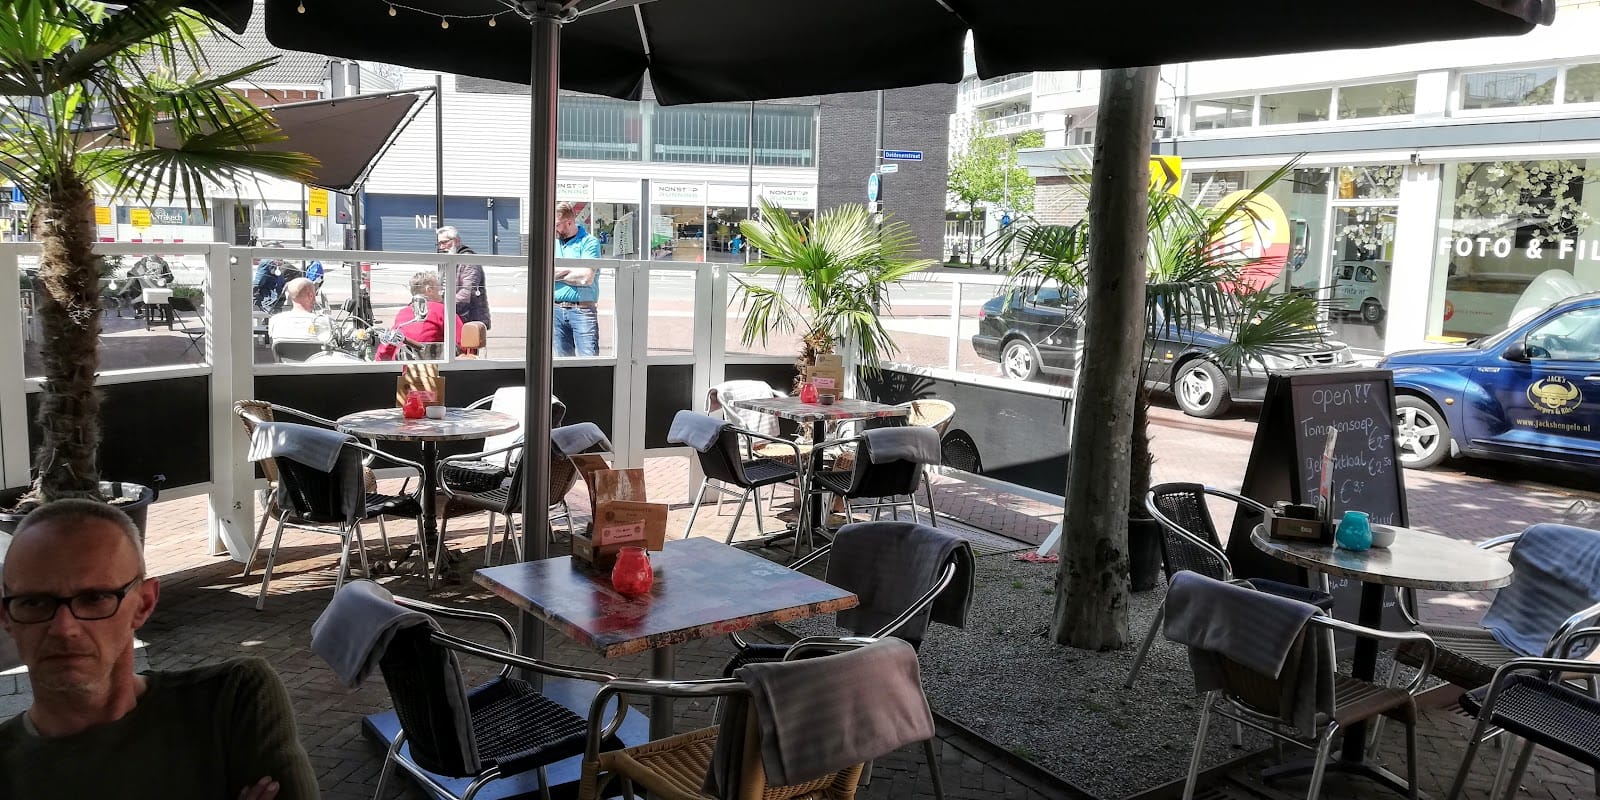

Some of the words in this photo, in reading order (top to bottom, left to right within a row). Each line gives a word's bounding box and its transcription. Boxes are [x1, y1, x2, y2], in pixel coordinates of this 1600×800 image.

[1439, 237, 1511, 257] FOTO
[1526, 239, 1542, 259] &
[1516, 419, 1591, 432] www.jackshengelo.nl
